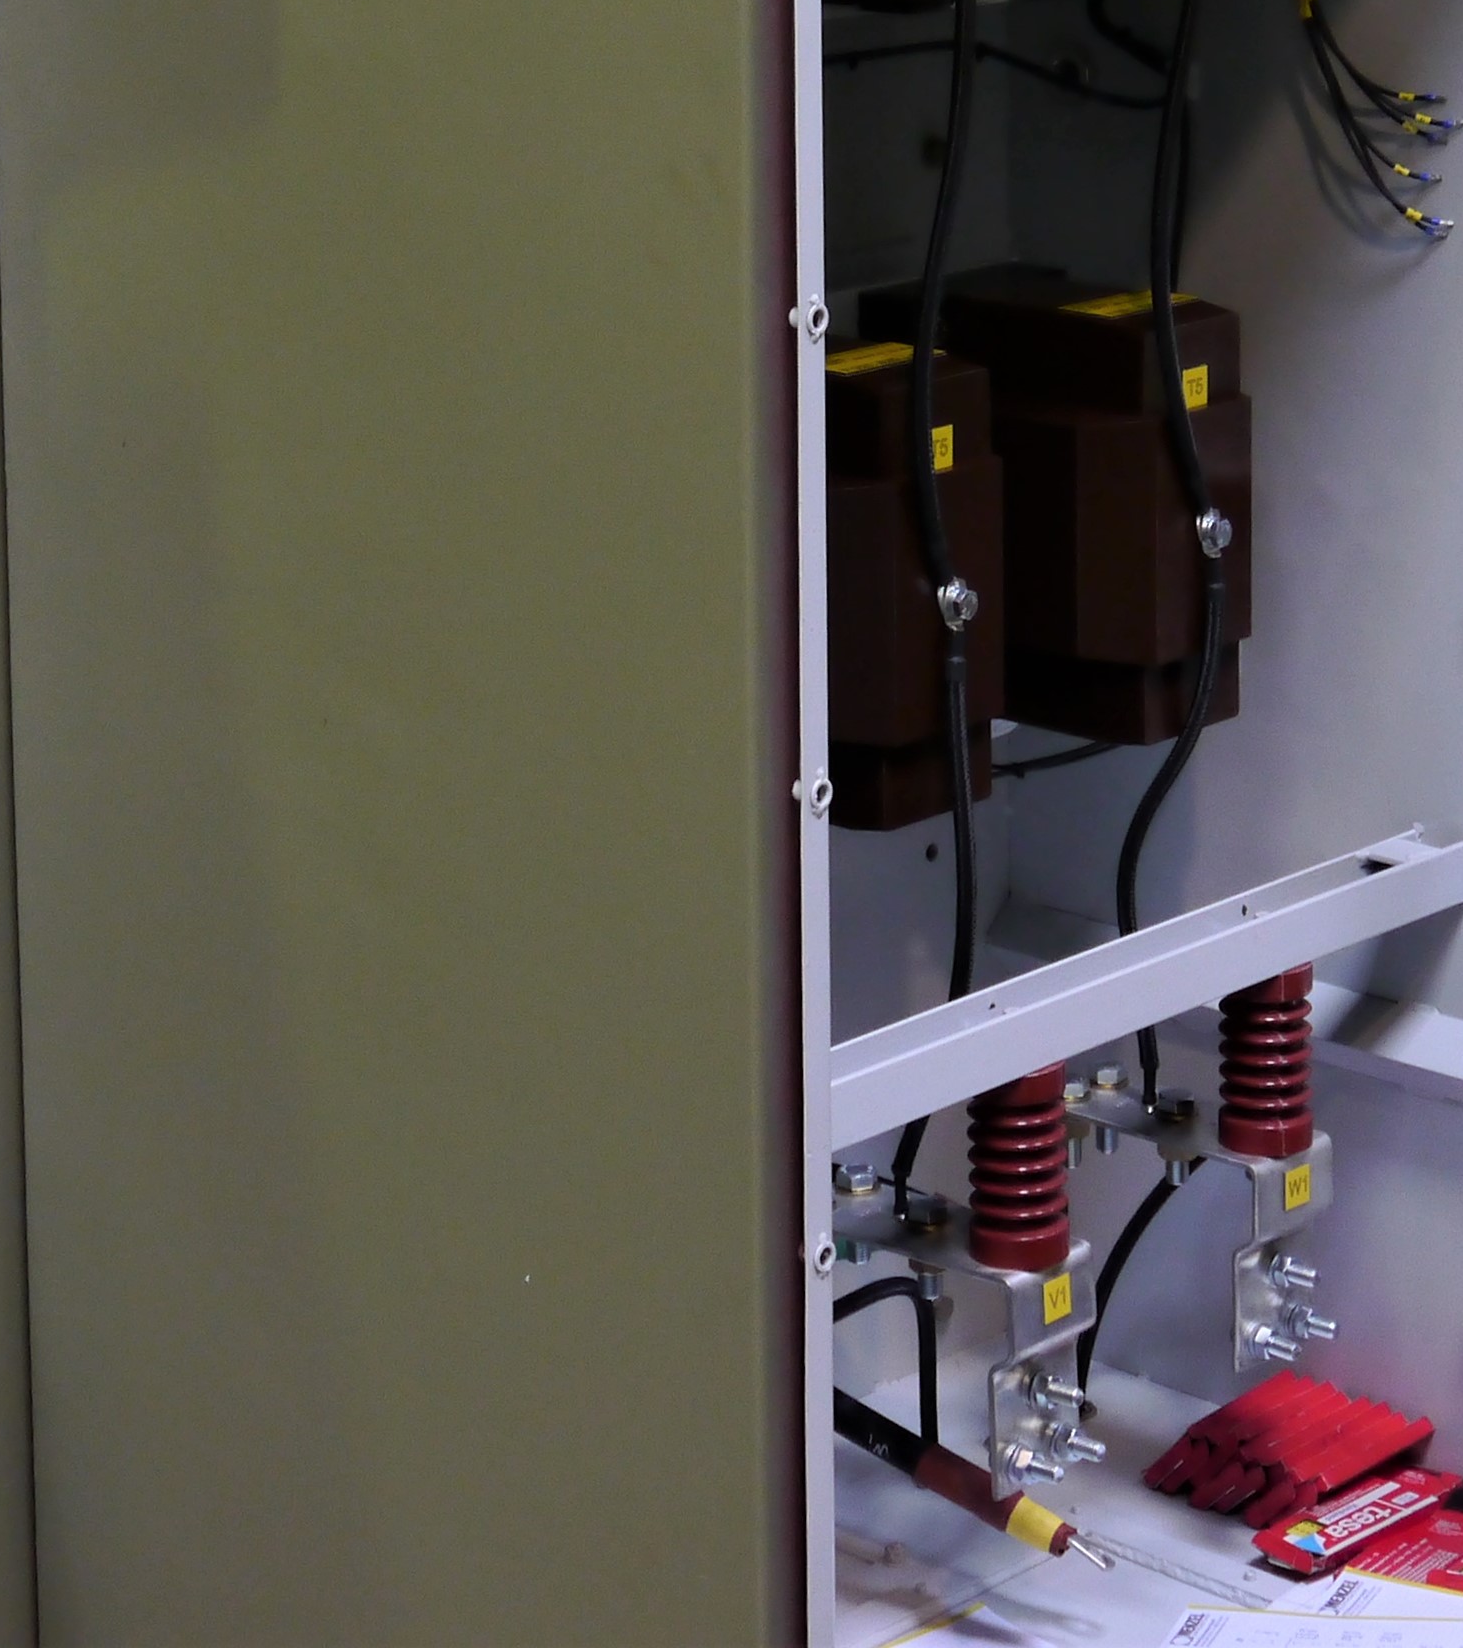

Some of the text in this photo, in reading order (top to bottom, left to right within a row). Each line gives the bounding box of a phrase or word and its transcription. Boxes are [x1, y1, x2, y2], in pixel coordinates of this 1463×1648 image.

[1186, 377, 1203, 397] T5
[1288, 1174, 1308, 1198] W1
[1048, 1285, 1066, 1309] V1
[1326, 1502, 1393, 1540] tesa
